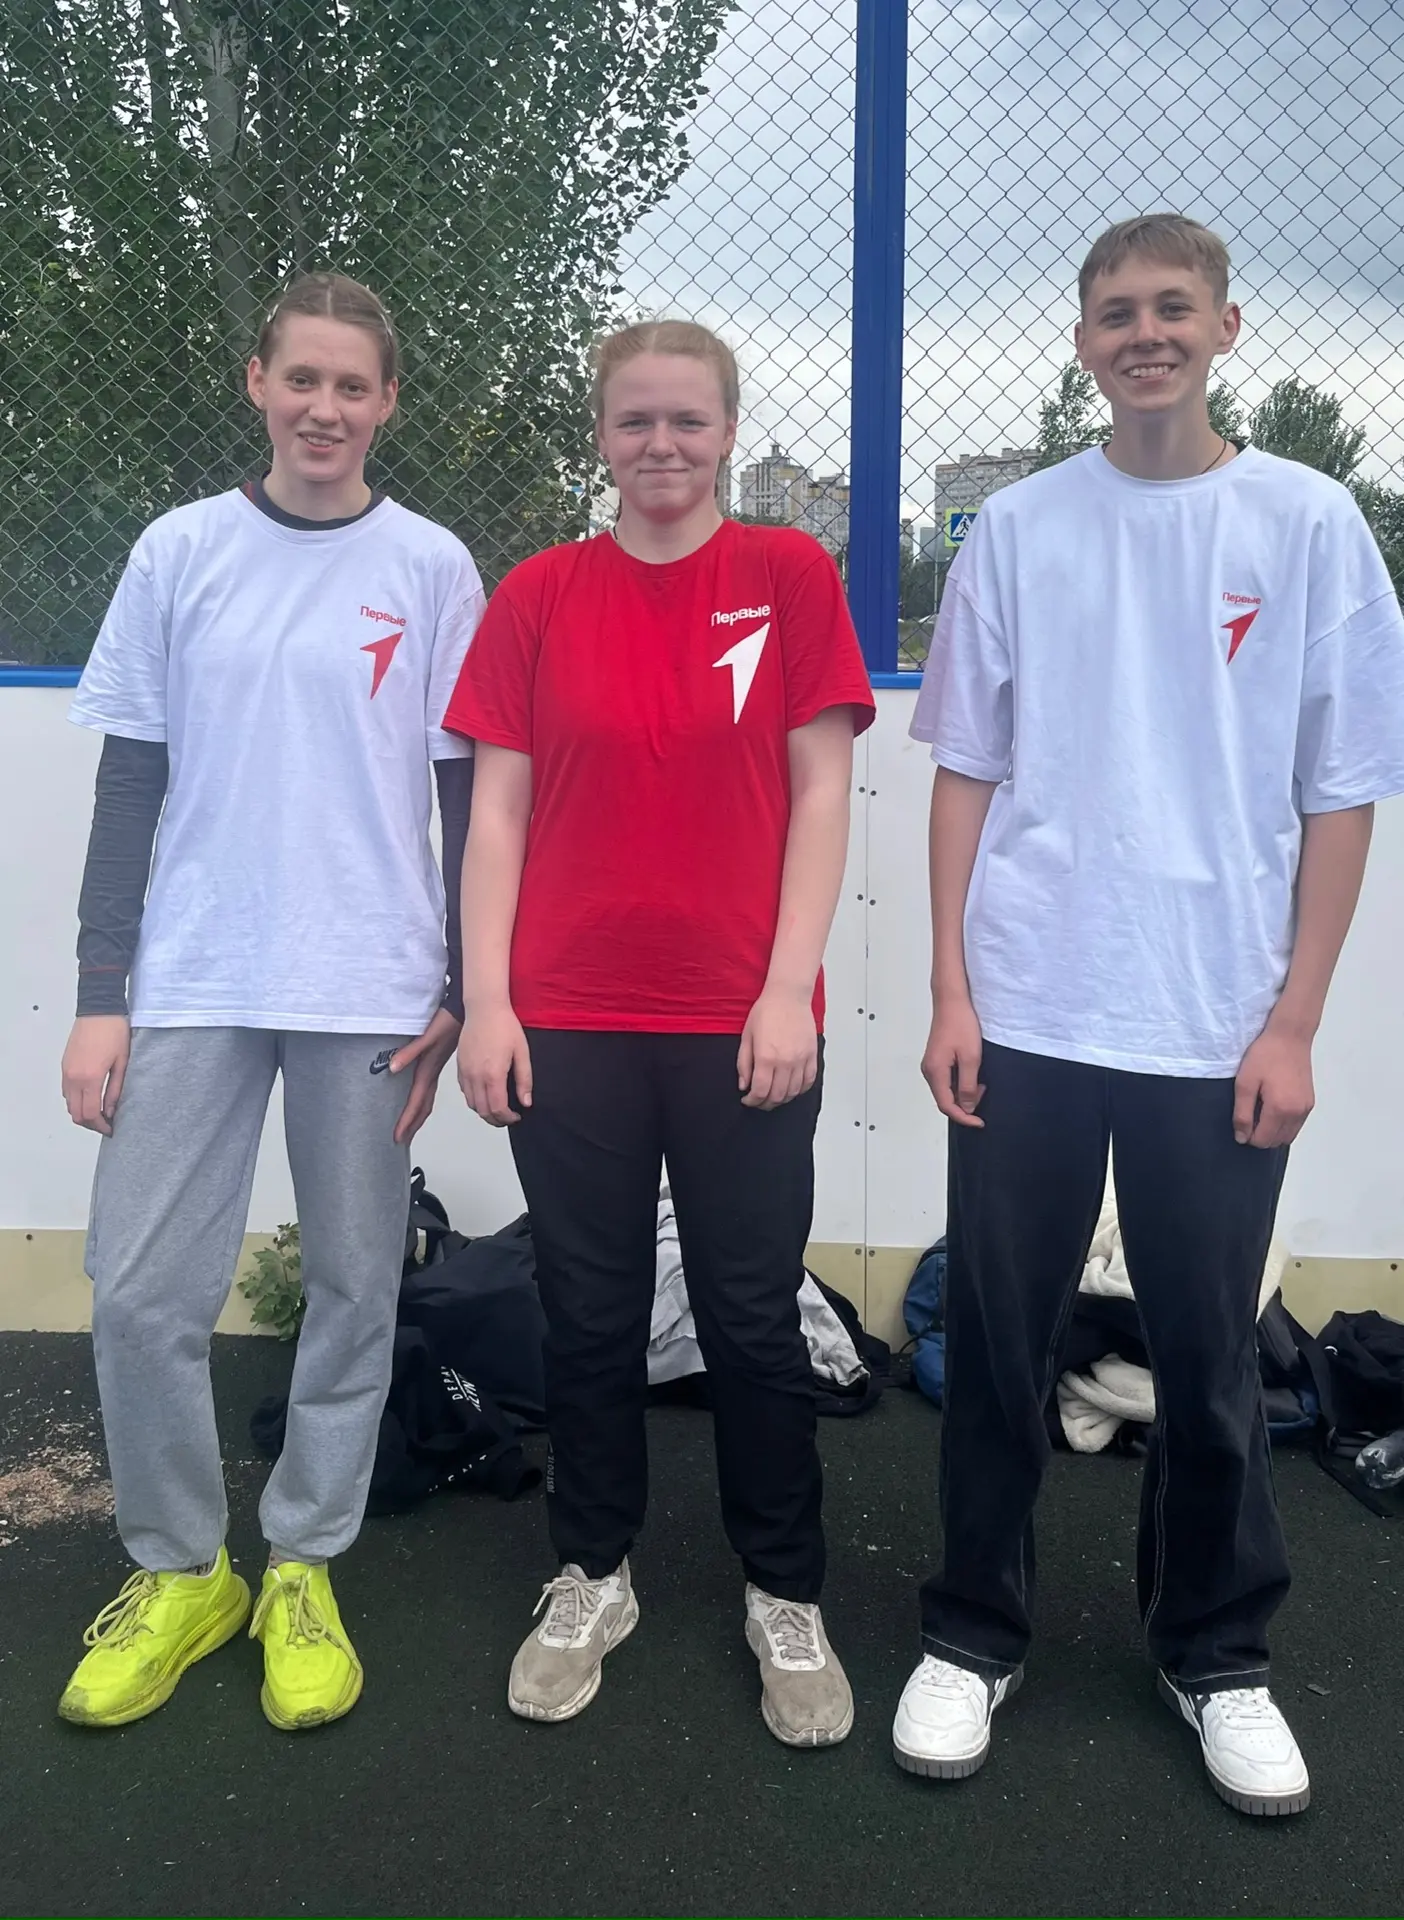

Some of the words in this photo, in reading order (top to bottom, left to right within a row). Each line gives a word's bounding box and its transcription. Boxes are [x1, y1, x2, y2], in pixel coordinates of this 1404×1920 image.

[1222, 592, 1261, 605] Первые
[360, 605, 407, 627] Первые
[711, 604, 771, 627] Первые
[441, 1365, 464, 1401] DEPA
